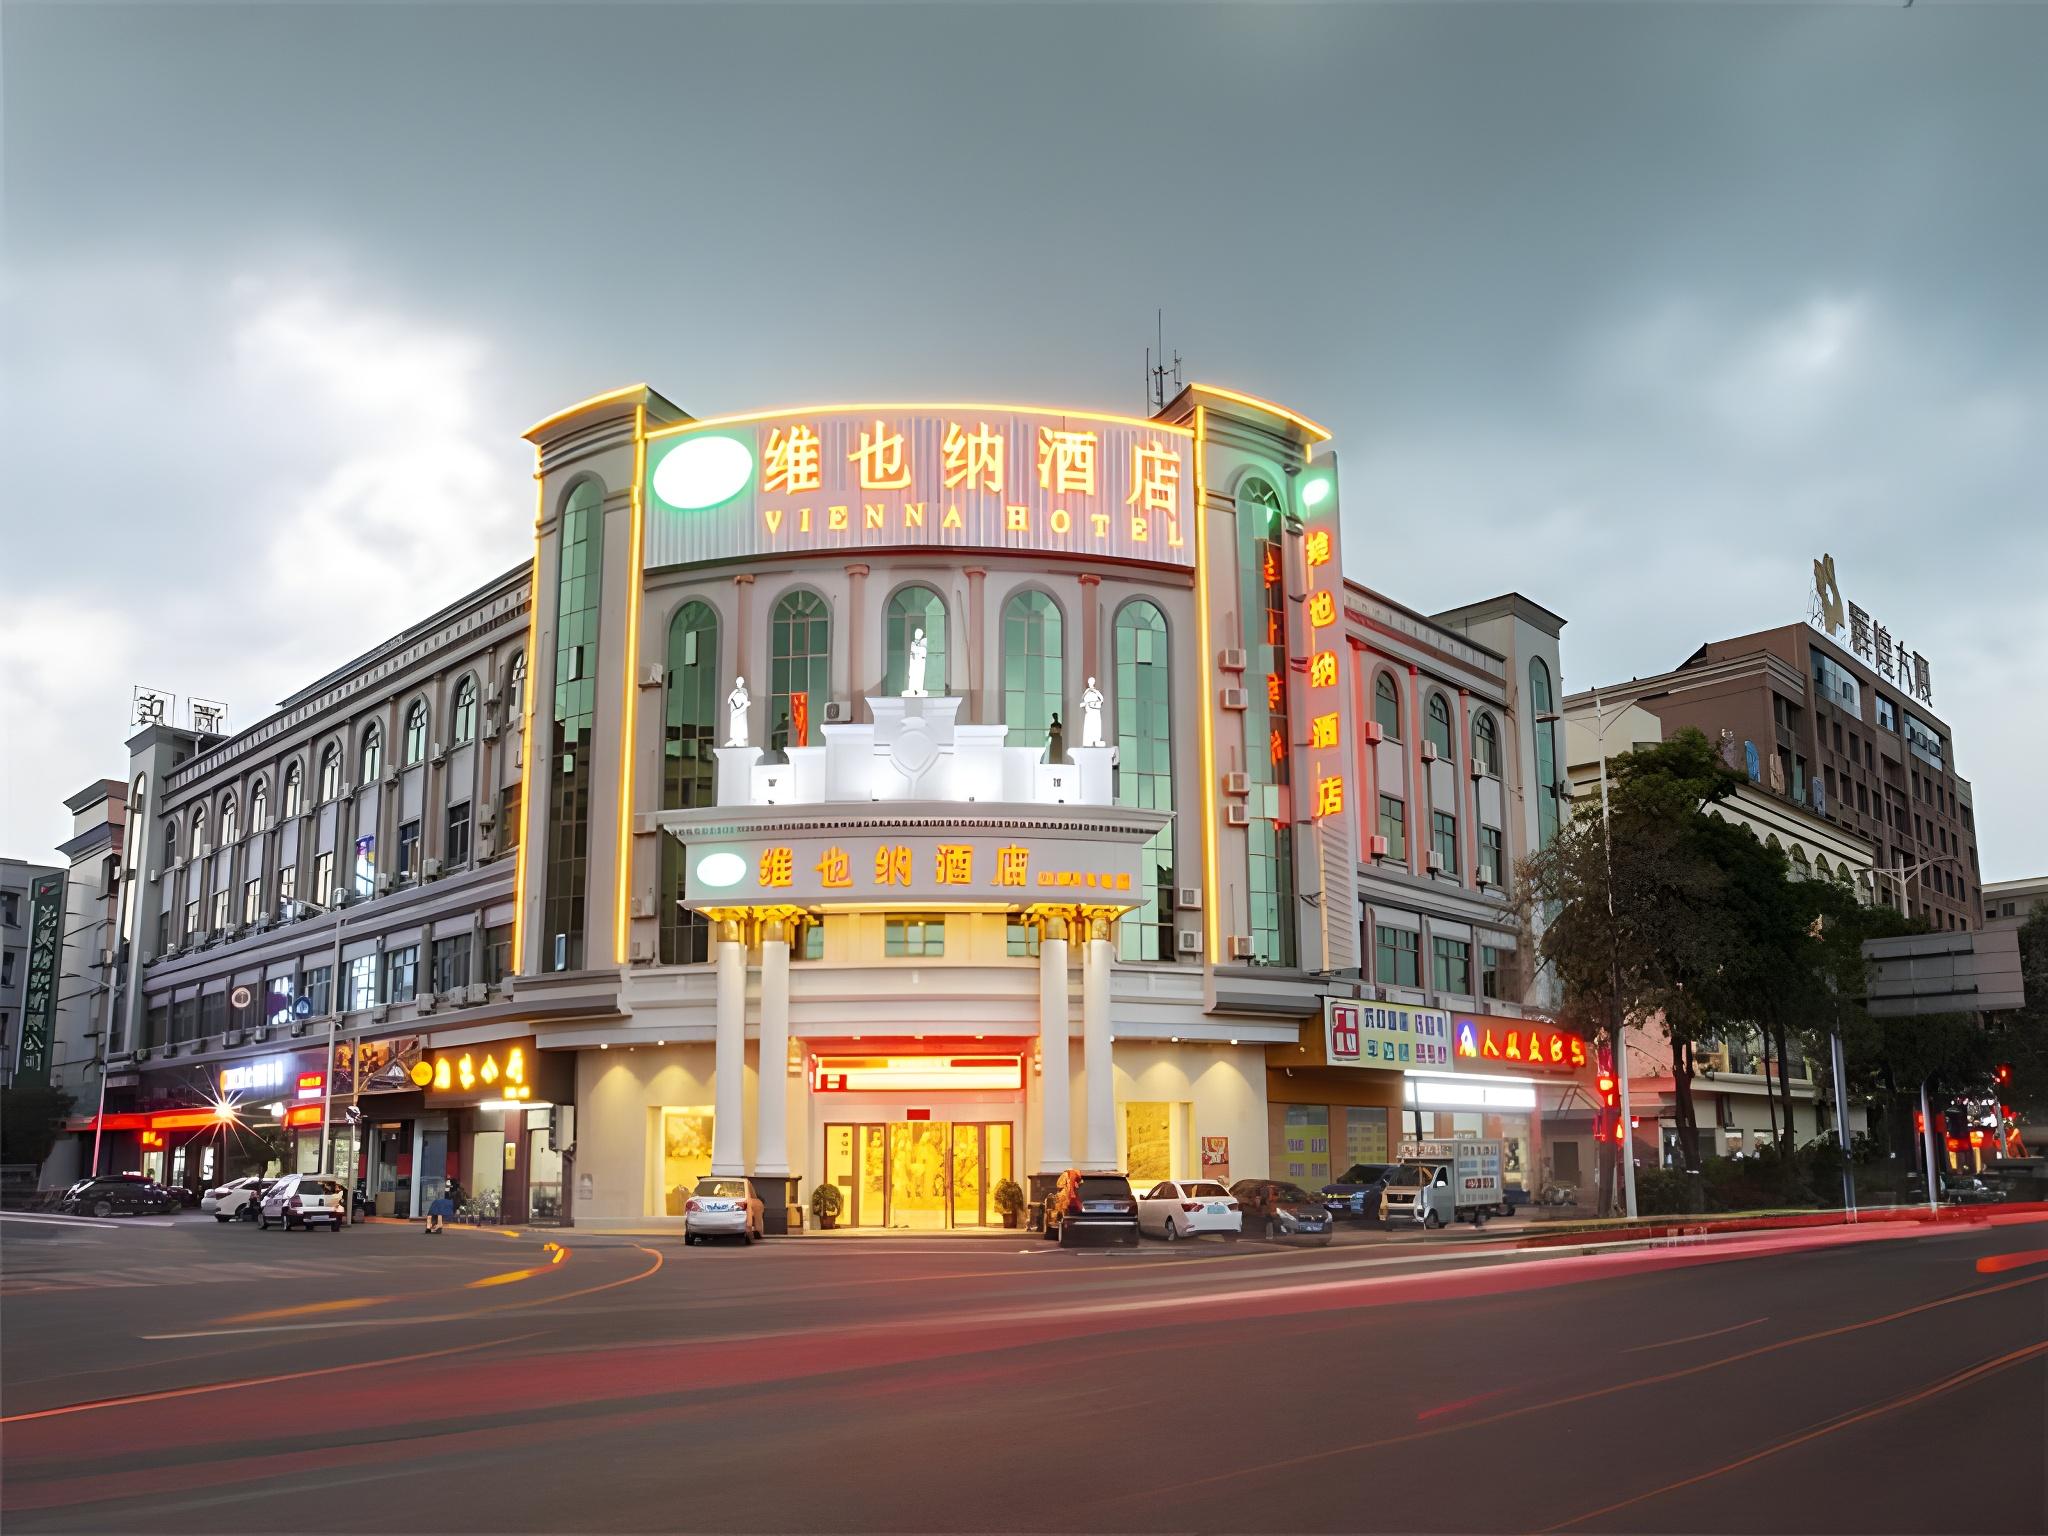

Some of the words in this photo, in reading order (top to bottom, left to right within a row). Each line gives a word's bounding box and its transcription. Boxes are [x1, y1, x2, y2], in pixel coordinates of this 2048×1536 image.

[763, 420, 1181, 512] 维也纳酒店
[765, 502, 963, 534] VIENNA
[1006, 505, 1184, 546] HOTEL
